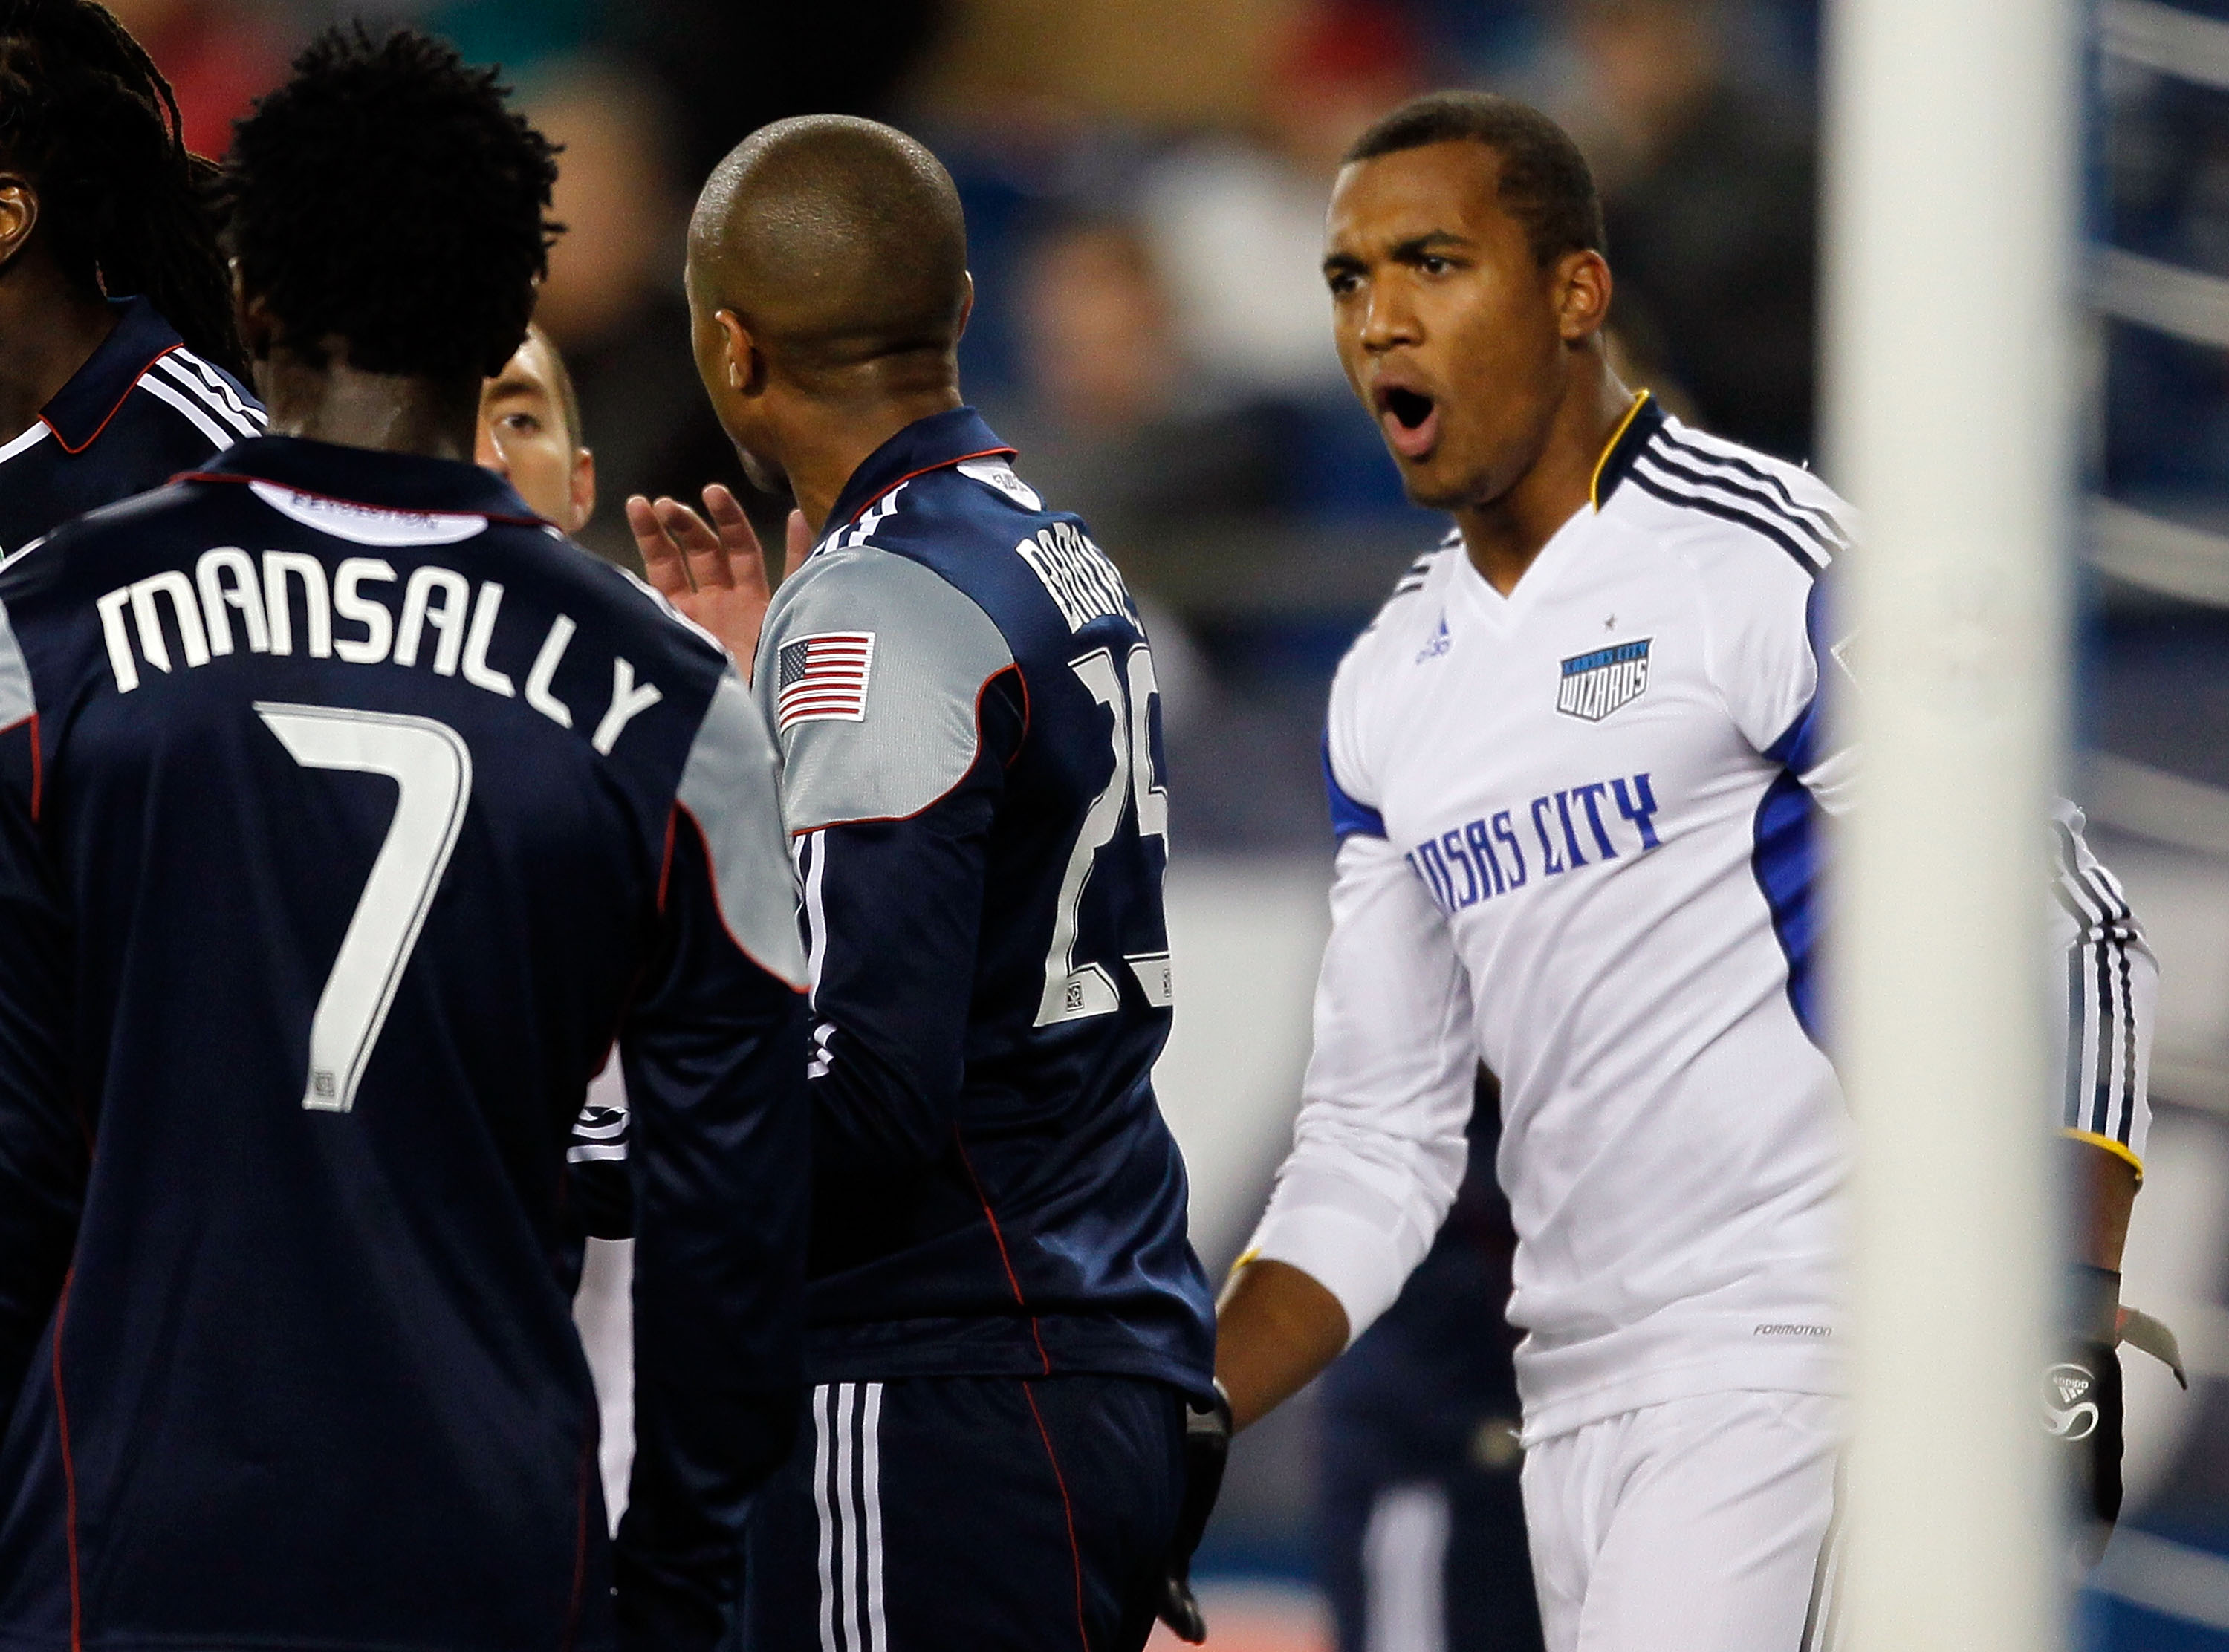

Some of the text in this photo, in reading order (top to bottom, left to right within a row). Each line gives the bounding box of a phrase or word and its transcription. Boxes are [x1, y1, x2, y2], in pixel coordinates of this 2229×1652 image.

[97, 546, 663, 757] MANSALLY
[1559, 657, 1647, 719] WIZARDS
[252, 700, 473, 1113] 7
[1033, 643, 1173, 1028] 25
[1405, 773, 1662, 913] NSAS CITY
